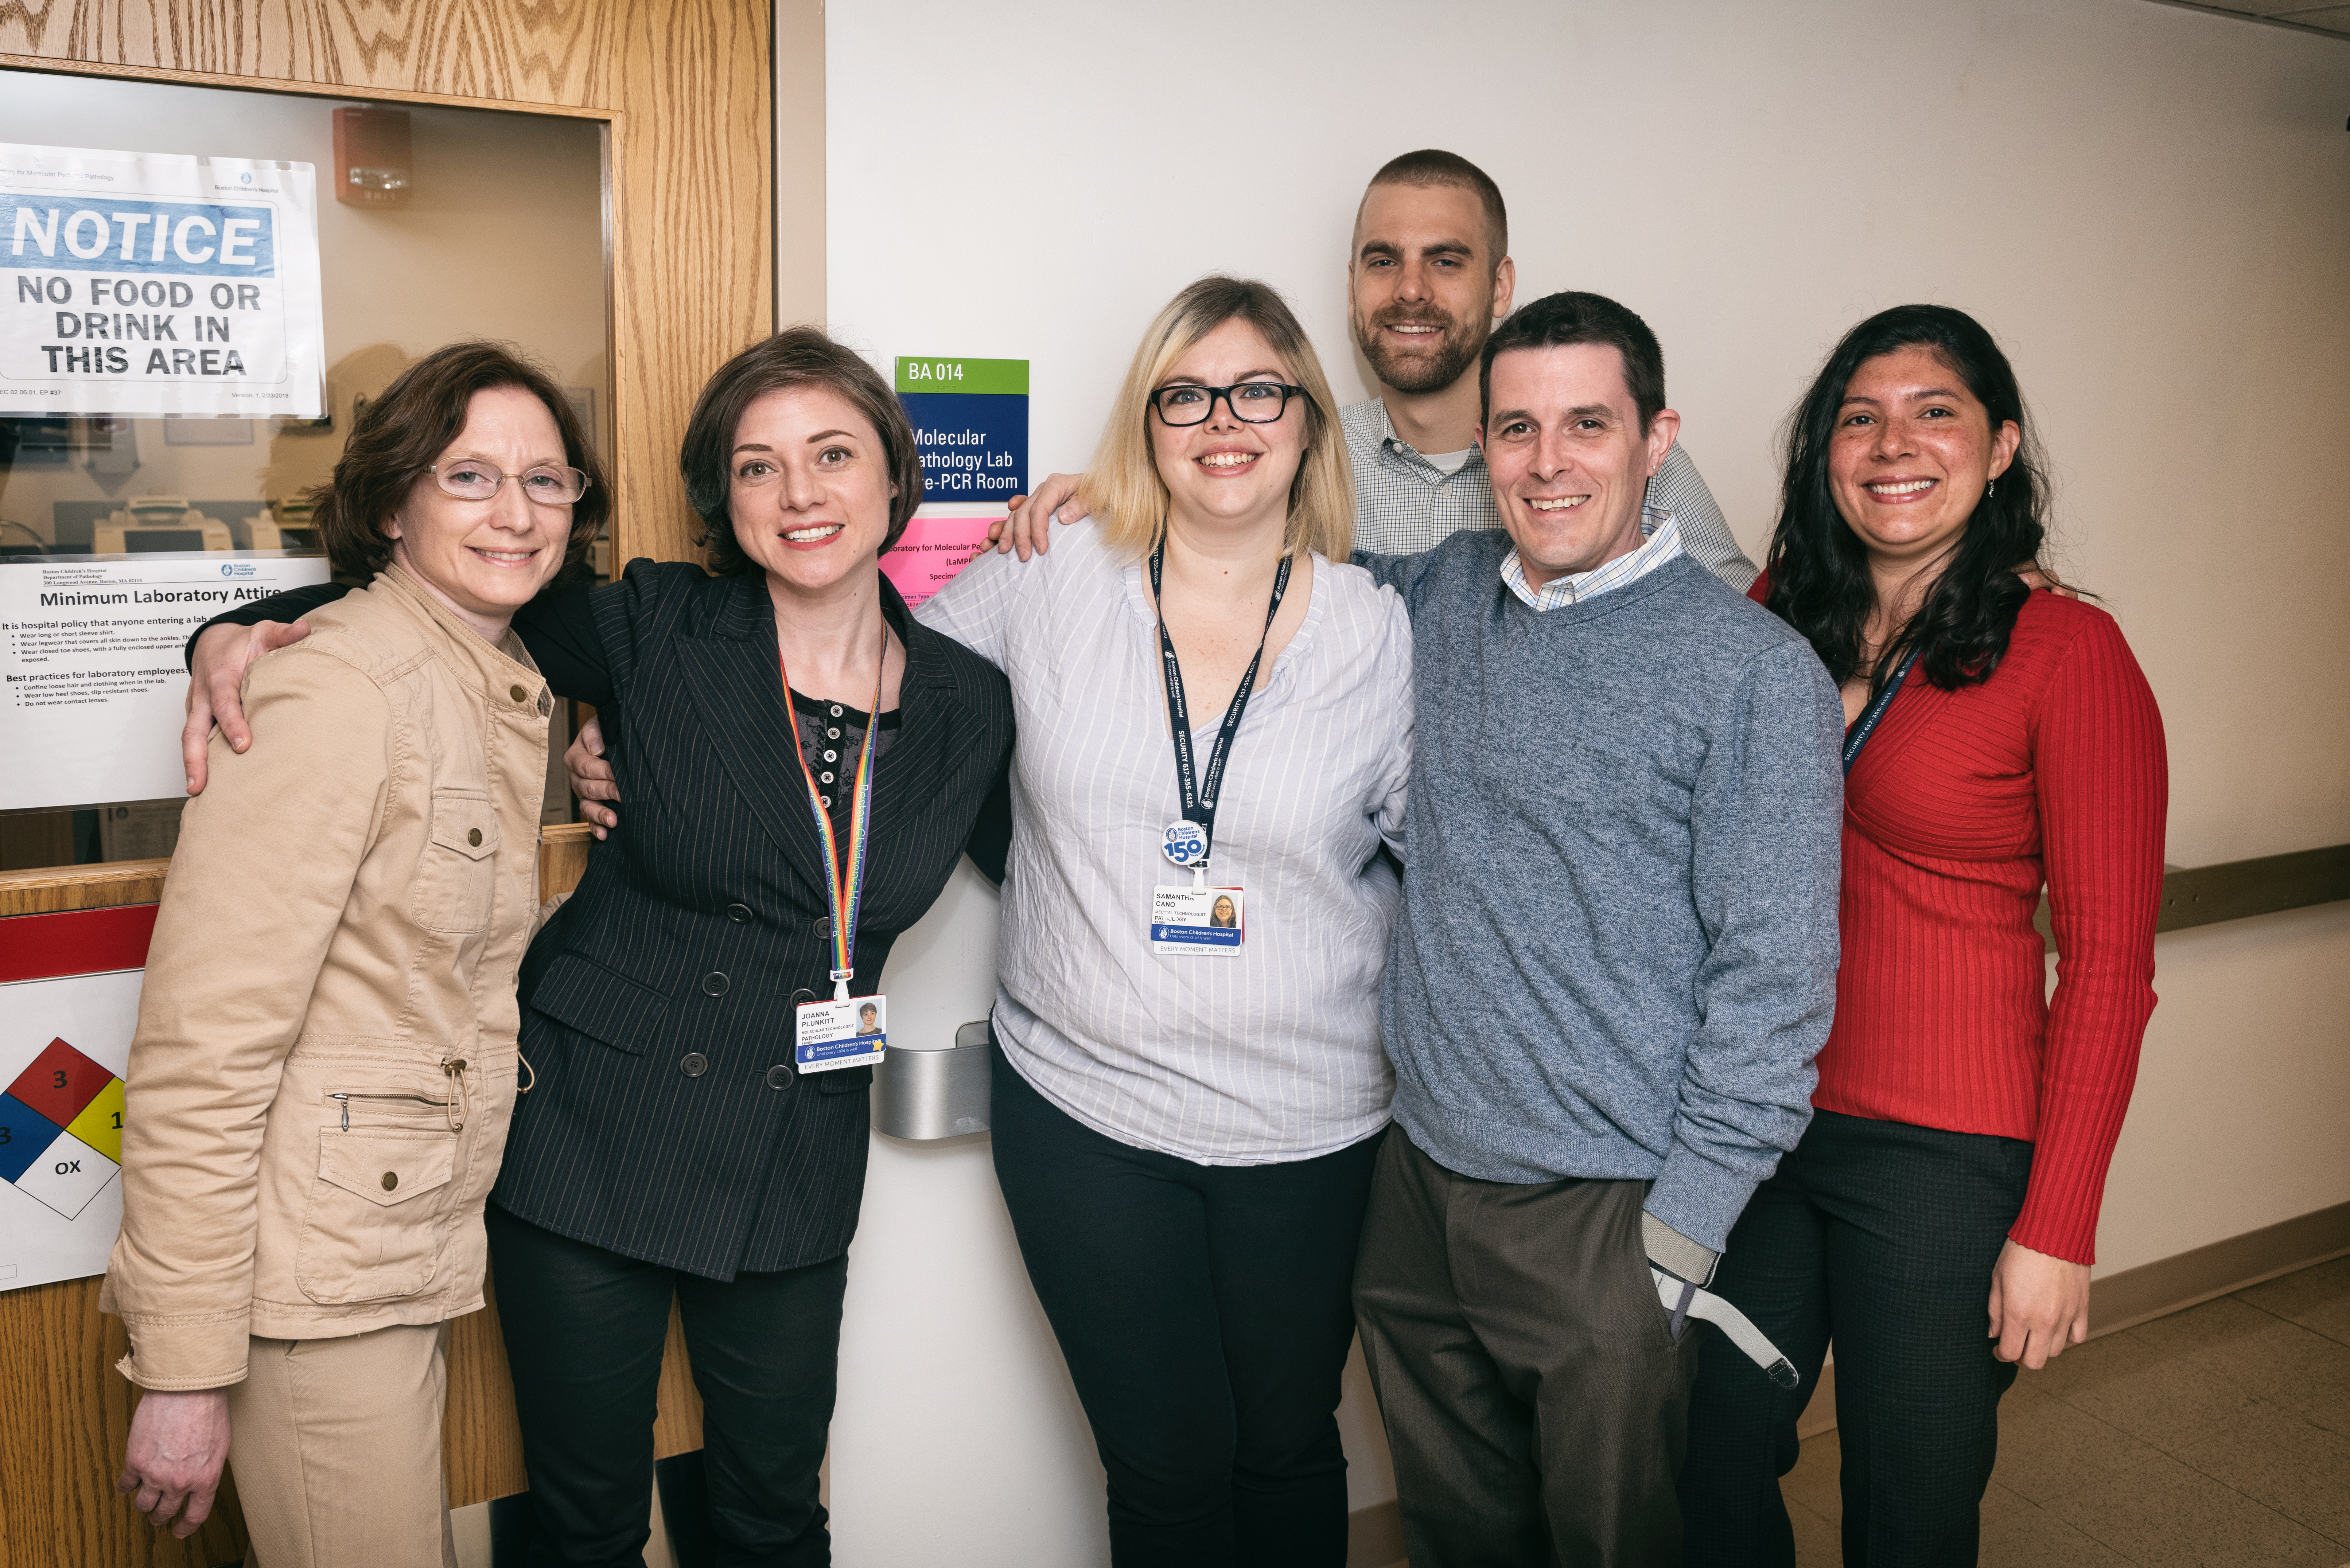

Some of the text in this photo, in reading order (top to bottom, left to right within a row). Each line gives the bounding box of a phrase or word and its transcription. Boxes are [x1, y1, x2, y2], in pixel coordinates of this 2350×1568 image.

[12, 208, 260, 265] NOTICE
[18, 276, 261, 310] NO FOOD OR
[56, 312, 229, 342] DRINK IN
[41, 346, 247, 376] THIS AREA
[909, 363, 963, 380] BA 014
[910, 429, 986, 445] Molecular
[919, 451, 1012, 471] athology Lab
[923, 473, 1018, 489] e-PCR Room
[41, 592, 128, 606] Minimum
[134, 589, 228, 604] Laboratory
[22, 621, 58, 629] hospital
[61, 620, 87, 629] policy
[147, 616, 184, 625] entering
[29, 673, 70, 682] practices
[88, 670, 135, 678] laboratory
[138, 668, 188, 676] employees:
[1227, 660, 1256, 727] SECURITY 617-355-6121
[1845, 692, 1891, 761] SECURITY 617-355-6121
[863, 718, 876, 756] Friends
[1209, 757, 1218, 780] Children's
[1215, 738, 1224, 757] Hospital
[1179, 730, 1193, 808] SECURITY 617-355-6121
[1164, 839, 1202, 862] 150
[844, 784, 869, 937] Boston Children's Hospital
[821, 834, 841, 937] Boston Children's
[802, 1011, 829, 1019] JOANNA
[802, 1018, 834, 1027] PLUNKITT
[802, 1033, 833, 1041] PATHOLOGY
[825, 1058, 851, 1066] MOMENT
[853, 1055, 879, 1063] MATTERS
[54, 1070, 67, 1089] 3
[111, 1112, 123, 1129] 1
[0, 1127, 11, 1145] 3
